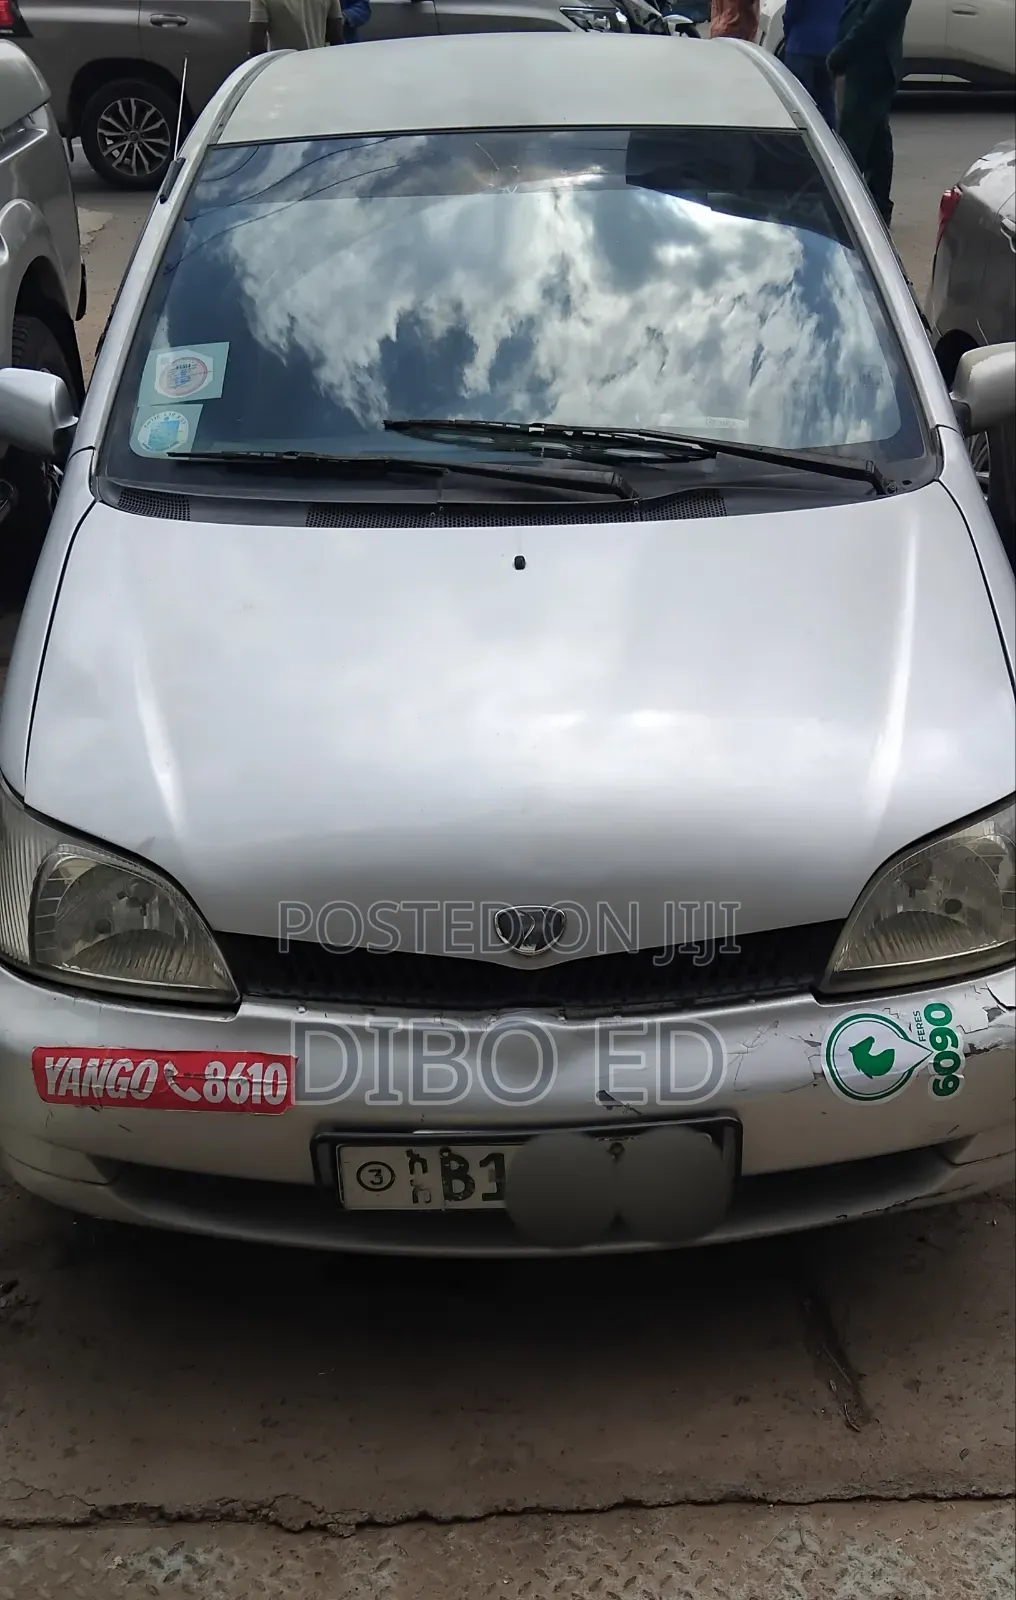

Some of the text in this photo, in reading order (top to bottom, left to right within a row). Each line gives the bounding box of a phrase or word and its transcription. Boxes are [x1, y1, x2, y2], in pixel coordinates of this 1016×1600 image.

[913, 1010, 927, 1042] FERES
[923, 1002, 961, 1097] 6090
[45, 1056, 288, 1105] YANGO 8610
